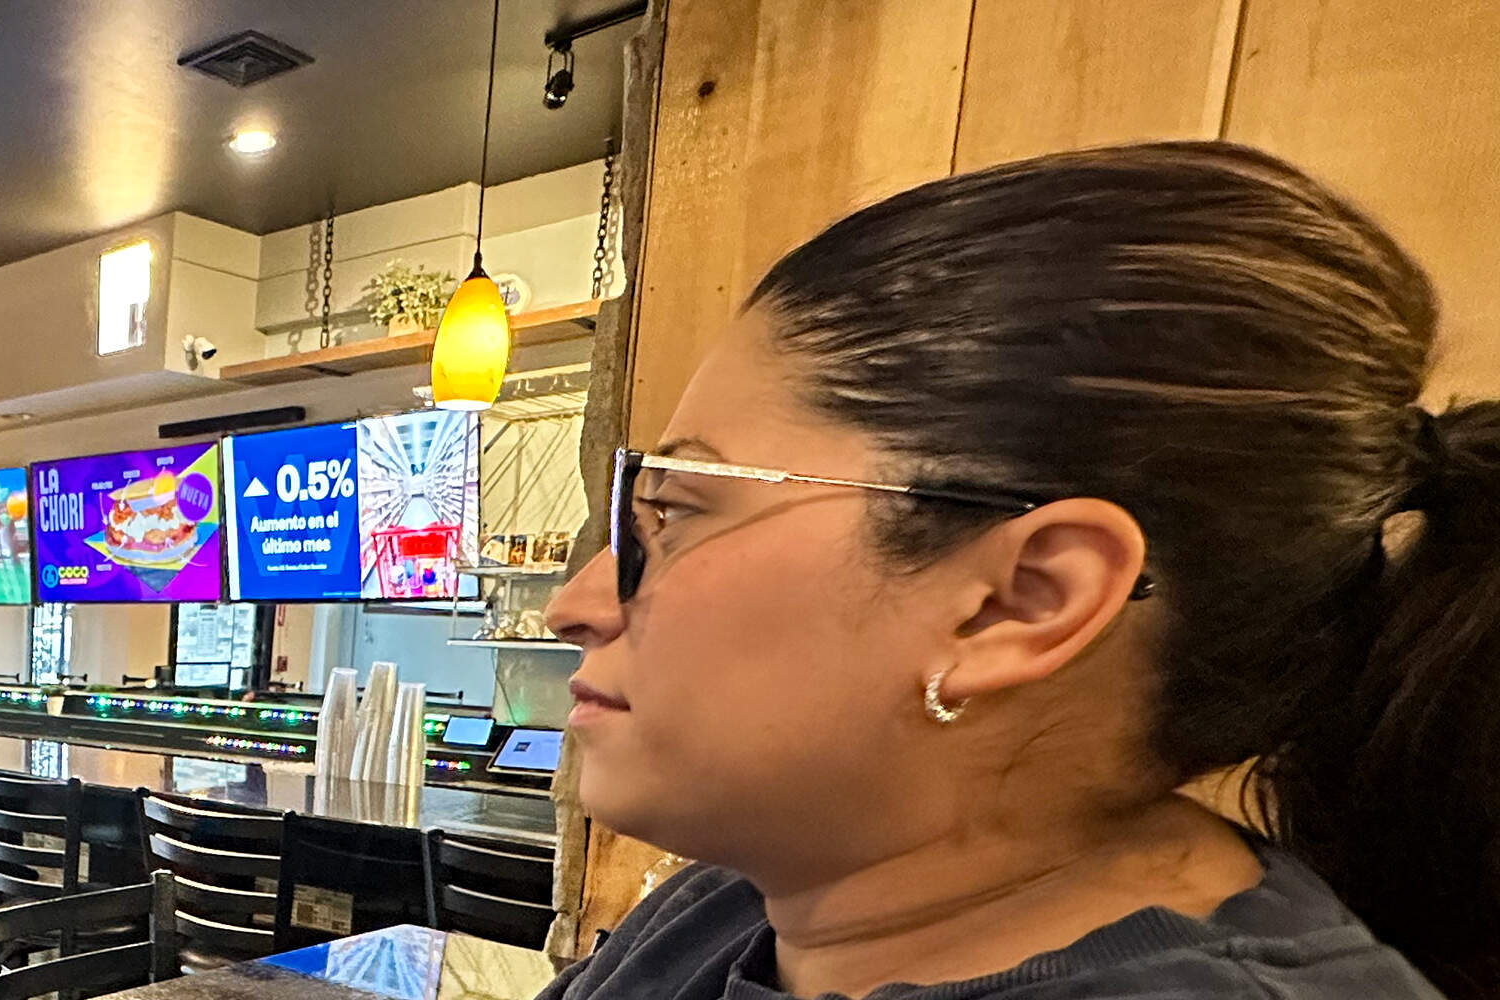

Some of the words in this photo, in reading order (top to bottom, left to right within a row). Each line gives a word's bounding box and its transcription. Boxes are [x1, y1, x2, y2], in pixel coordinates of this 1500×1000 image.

[39, 468, 60, 495] LA
[276, 457, 355, 503] 0.5%
[179, 484, 210, 511] NUEVA
[39, 491, 85, 532] CHORI
[250, 513, 307, 533] Aumento
[308, 515, 324, 530] en
[326, 511, 339, 528] el
[262, 537, 302, 555] último
[302, 538, 331, 553] mes
